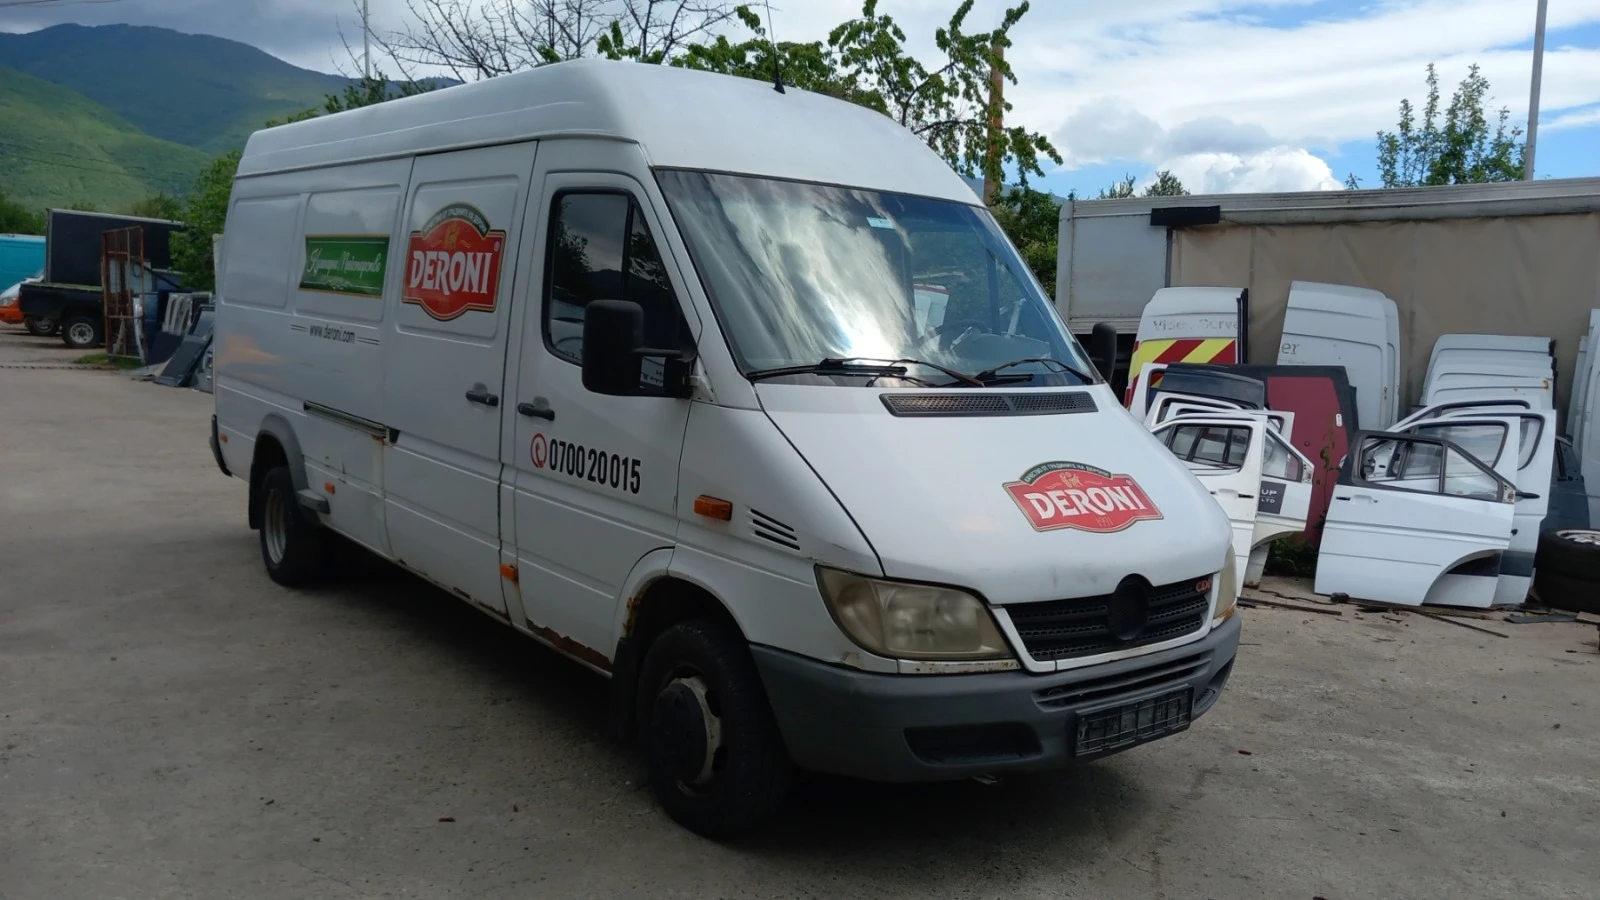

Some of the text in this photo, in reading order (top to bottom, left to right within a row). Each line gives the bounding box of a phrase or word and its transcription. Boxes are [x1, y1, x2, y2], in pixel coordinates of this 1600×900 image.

[409, 250, 493, 296] DERONI
[310, 323, 356, 345] www.deroni.com
[1024, 485, 1148, 520] DERONI
[1095, 516, 1114, 528] 1991
[1195, 578, 1210, 592] CDI
